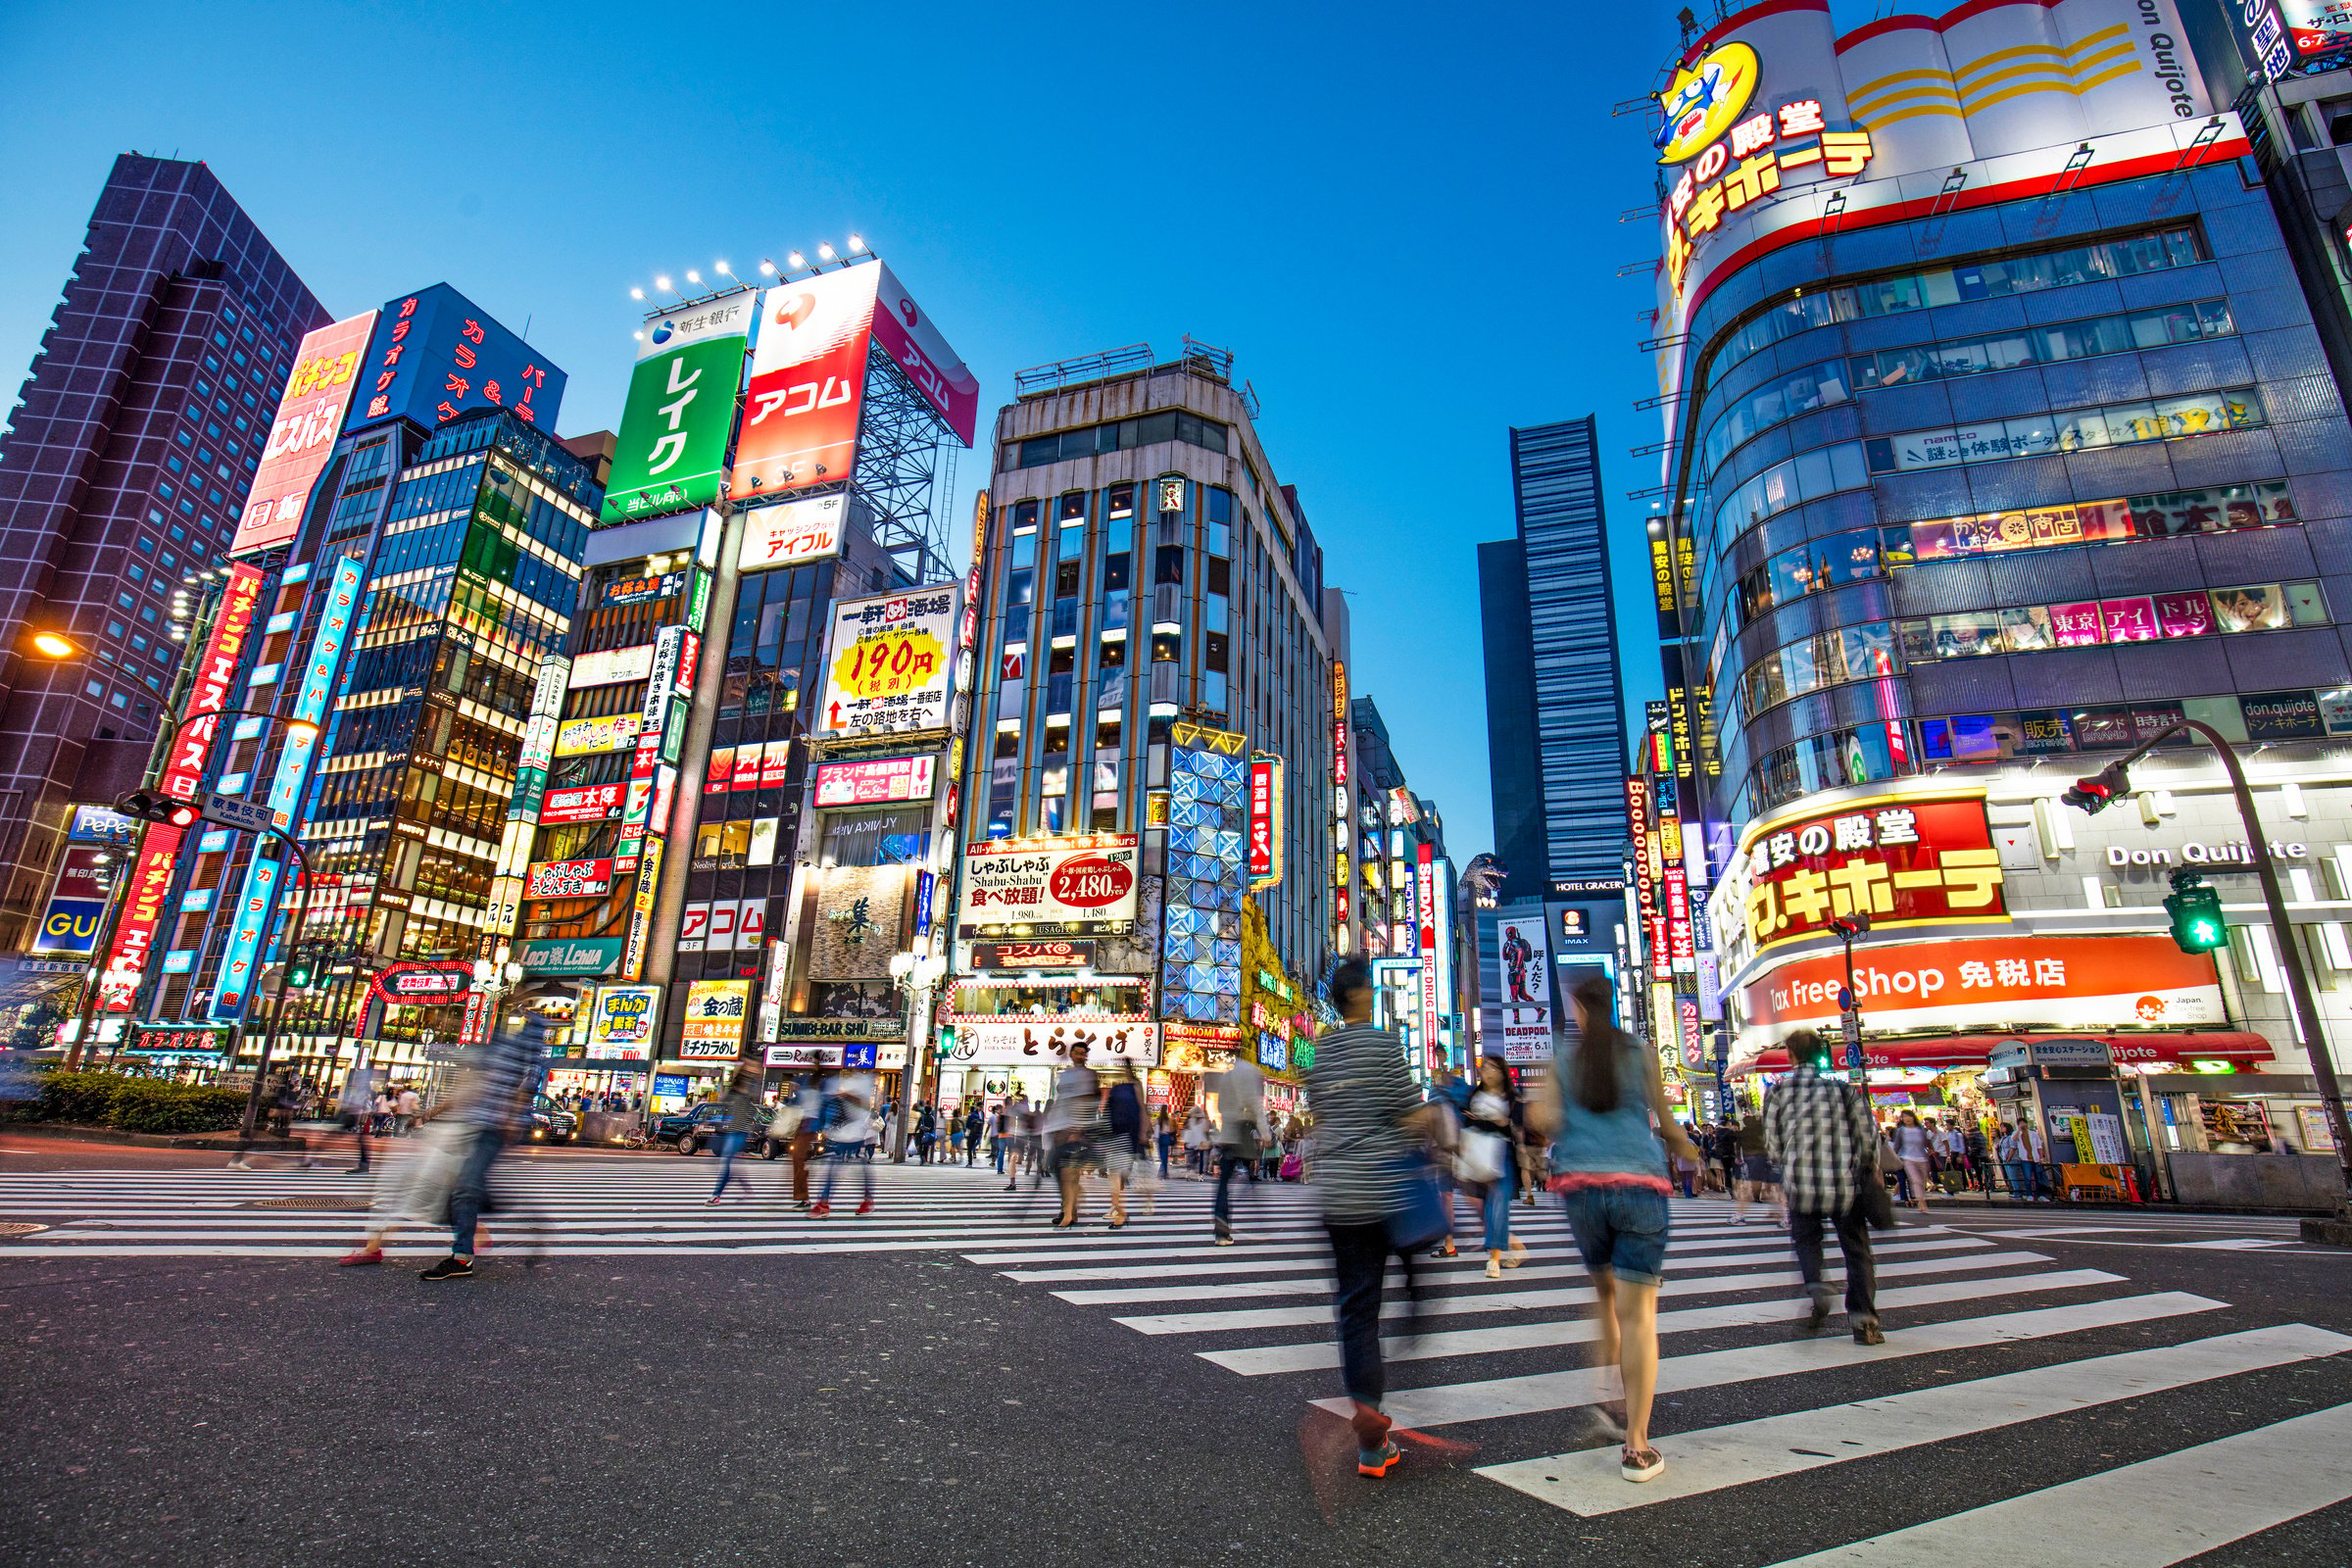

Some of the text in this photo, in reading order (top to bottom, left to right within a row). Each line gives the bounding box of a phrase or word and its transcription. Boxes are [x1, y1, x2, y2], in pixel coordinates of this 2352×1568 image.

[2150, 32, 2194, 119] Quijote
[679, 305, 741, 333] 新生銀行
[368, 298, 418, 418] カラオケ館
[283, 351, 358, 402] パチンコ
[902, 339, 950, 413] アコム
[482, 379, 502, 406] &
[751, 375, 852, 425] アコム
[648, 357, 703, 476] レイク
[263, 397, 340, 461] エスパス
[1924, 431, 1977, 445] namco
[769, 520, 835, 539] キャッシングなら
[767, 532, 833, 559] アイフル
[1652, 540, 1675, 612] 驚安の殿堂
[609, 576, 661, 598] お好み焼
[218, 577, 260, 654] パチンコ
[842, 594, 951, 624] 一軒め酒場
[2054, 612, 2097, 633] 東京
[679, 647, 696, 686] アイフル
[851, 639, 934, 681] 190円
[646, 637, 670, 718] お好み焼き本陣
[846, 689, 943, 710] 一軒め酒場一番街店
[2245, 699, 2316, 717] don.quijote
[179, 656, 233, 771] エスパス
[849, 707, 934, 729] 左の路地を右へ
[2079, 716, 2126, 732] ブランド
[2134, 711, 2182, 729] 時計
[2247, 714, 2319, 731] ドン・キホーテ
[562, 717, 637, 741] お好み 焼き
[569, 724, 609, 748] もんじゃ
[2025, 717, 2070, 739] 販売
[2082, 728, 2128, 742] BRAND
[588, 733, 609, 750] たこ
[736, 751, 788, 771] アイフル
[821, 760, 911, 780] ブランド高価買取
[711, 783, 723, 792] 5F
[890, 785, 907, 796] FREE
[912, 784, 929, 796] 1F
[1253, 773, 1268, 814] 居酒屋
[212, 796, 269, 821] 歌舞伎町
[219, 810, 255, 827] Kabukicho
[608, 806, 621, 817] 4F
[79, 815, 127, 834] PePe
[1077, 839, 1093, 849] for
[1095, 838, 1103, 848] 2
[1752, 808, 1920, 876] 驚安の殿堂
[2107, 839, 2308, 867] Don Quijte
[534, 859, 595, 880] しゃぶしゃぶ
[639, 858, 655, 895] 金の蔵
[970, 856, 1051, 876] しゃぶしゃぶ
[133, 852, 173, 921] パチンコ
[529, 878, 583, 897] うどんすき
[595, 881, 607, 894] 4F
[1057, 874, 1111, 902] 2,480
[1418, 862, 1435, 930] SHIDAX
[1556, 881, 1625, 892] HOTEL GRACERY
[639, 896, 650, 906] 2F
[46, 912, 98, 938] GU
[683, 907, 763, 937] アコム
[1111, 920, 1133, 935] 5F
[221, 867, 273, 1006] カラオケ館
[626, 911, 644, 974] 東京チカラめし
[24, 961, 83, 974] 西武新宿駅
[1424, 955, 1434, 972] BIC
[1958, 957, 2067, 989] 免税店
[400, 974, 458, 990] 歌舞伎町一番街
[1425, 976, 1435, 1007] DRUG
[1771, 966, 1945, 1014] Tax Free Shop
[607, 997, 648, 1014] まんが
[703, 996, 745, 1017] 金の蔵
[2176, 996, 2205, 1004] Japan.
[612, 1015, 636, 1030] 喫茶
[703, 1022, 742, 1037] 焼き牛丼
[780, 1022, 843, 1036] SUMIBI-BAR
[1165, 1025, 1243, 1040] OKONOMI YAKI
[1504, 1026, 1550, 1037] DEADPOOL
[1681, 1001, 1703, 1064] カラオケ
[137, 1031, 218, 1050] カラオケ館
[689, 1039, 738, 1055] チカラめし
[955, 1026, 977, 1058] 虎
[2034, 1045, 2103, 1055] 安全安心ステーション
[793, 1050, 813, 1063] Roko
